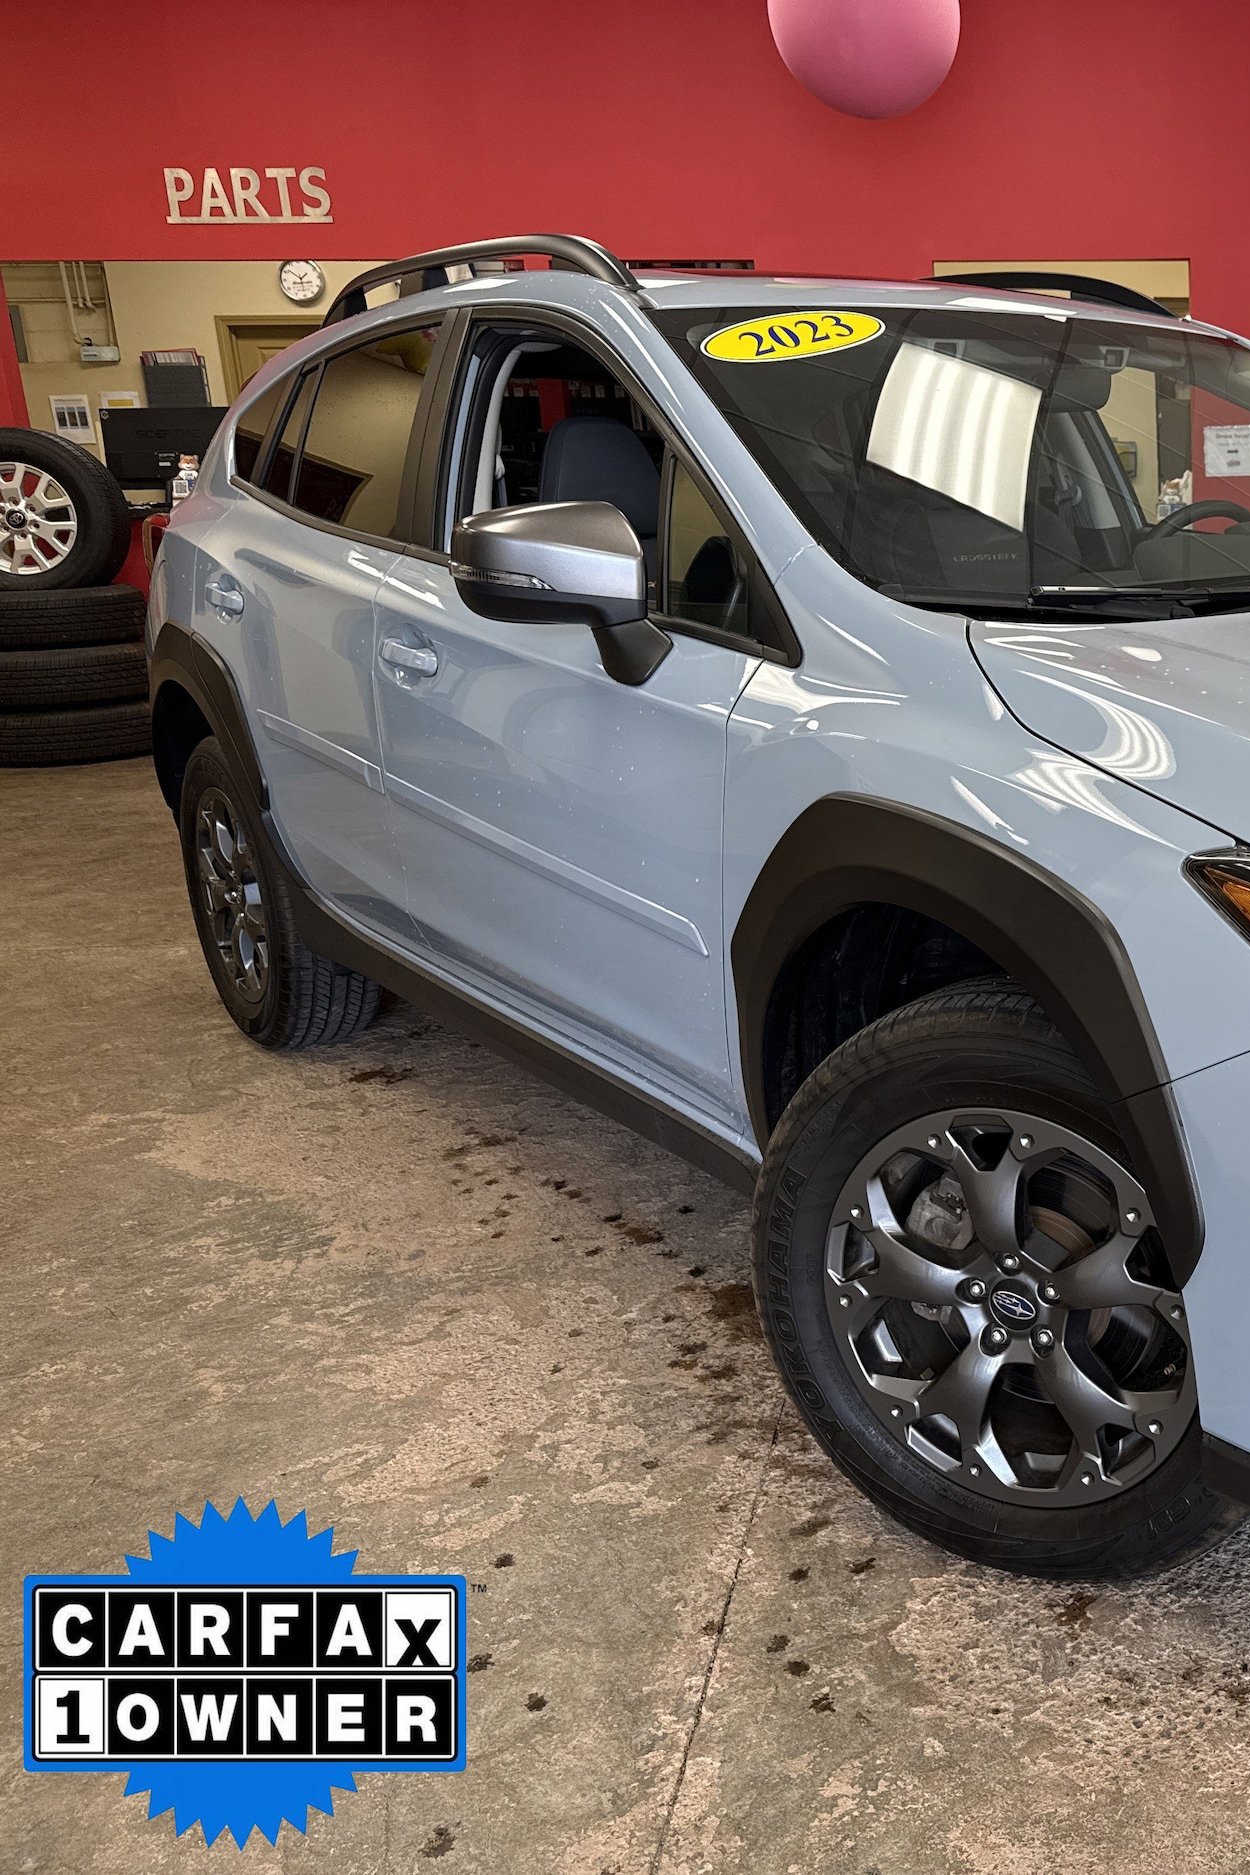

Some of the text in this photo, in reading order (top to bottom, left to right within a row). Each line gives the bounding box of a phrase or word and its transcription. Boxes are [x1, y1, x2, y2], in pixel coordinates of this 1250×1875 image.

[164, 166, 333, 219] PARTS
[738, 315, 854, 357] 2023
[767, 1164, 846, 1440] YOKOHAMA
